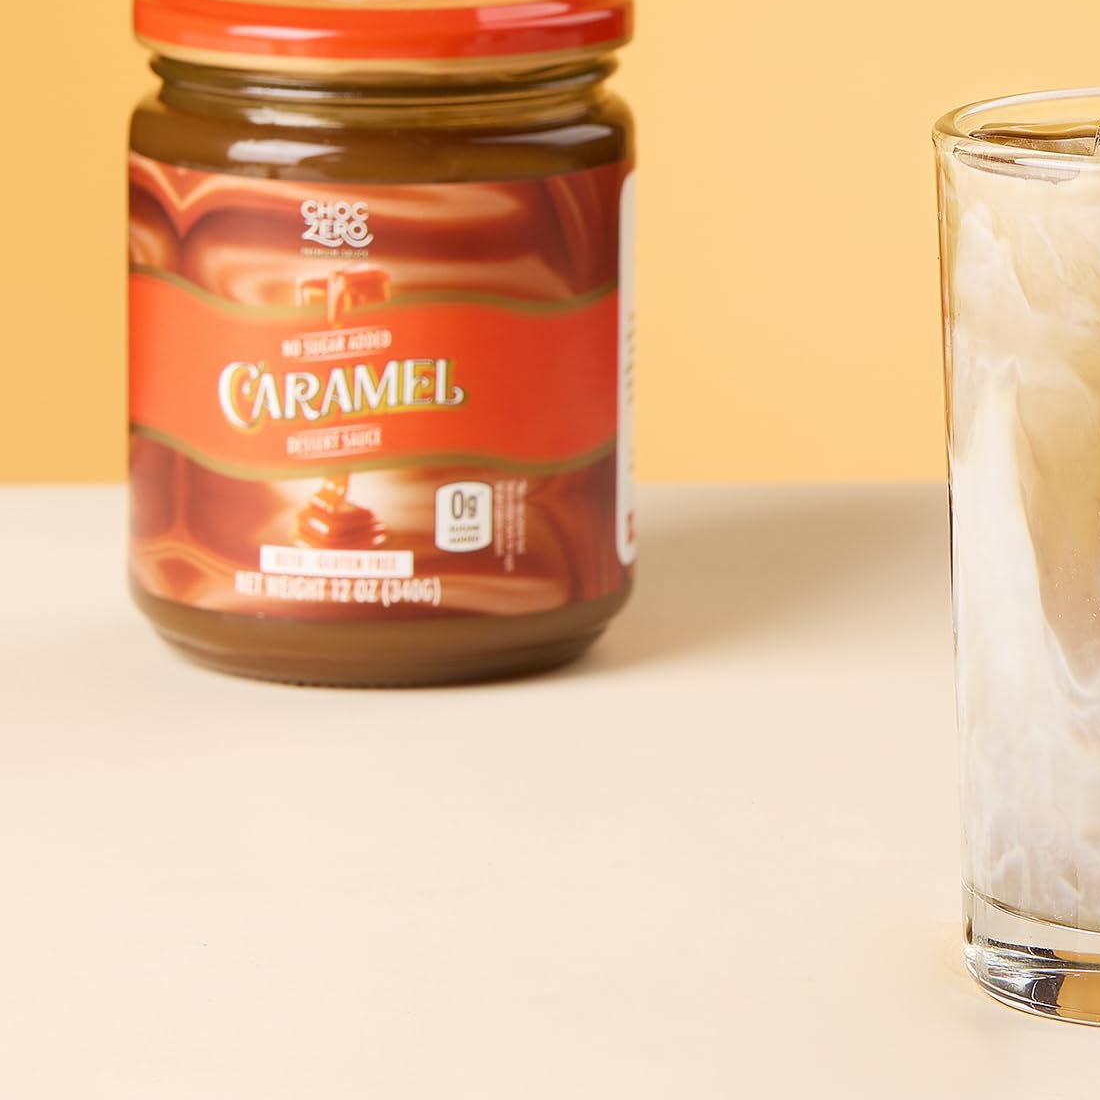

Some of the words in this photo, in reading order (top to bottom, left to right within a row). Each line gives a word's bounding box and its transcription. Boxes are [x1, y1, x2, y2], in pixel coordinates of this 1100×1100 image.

[301, 200, 369, 221] CHOC
[302, 219, 374, 248] ZERO
[218, 359, 465, 429] CARAMEL
[341, 427, 381, 450] SAUCE
[235, 570, 263, 596] NET
[265, 573, 326, 601] WEIGHT
[331, 577, 351, 603] 12
[354, 577, 379, 603] OZ
[381, 575, 442, 608] (340G)
